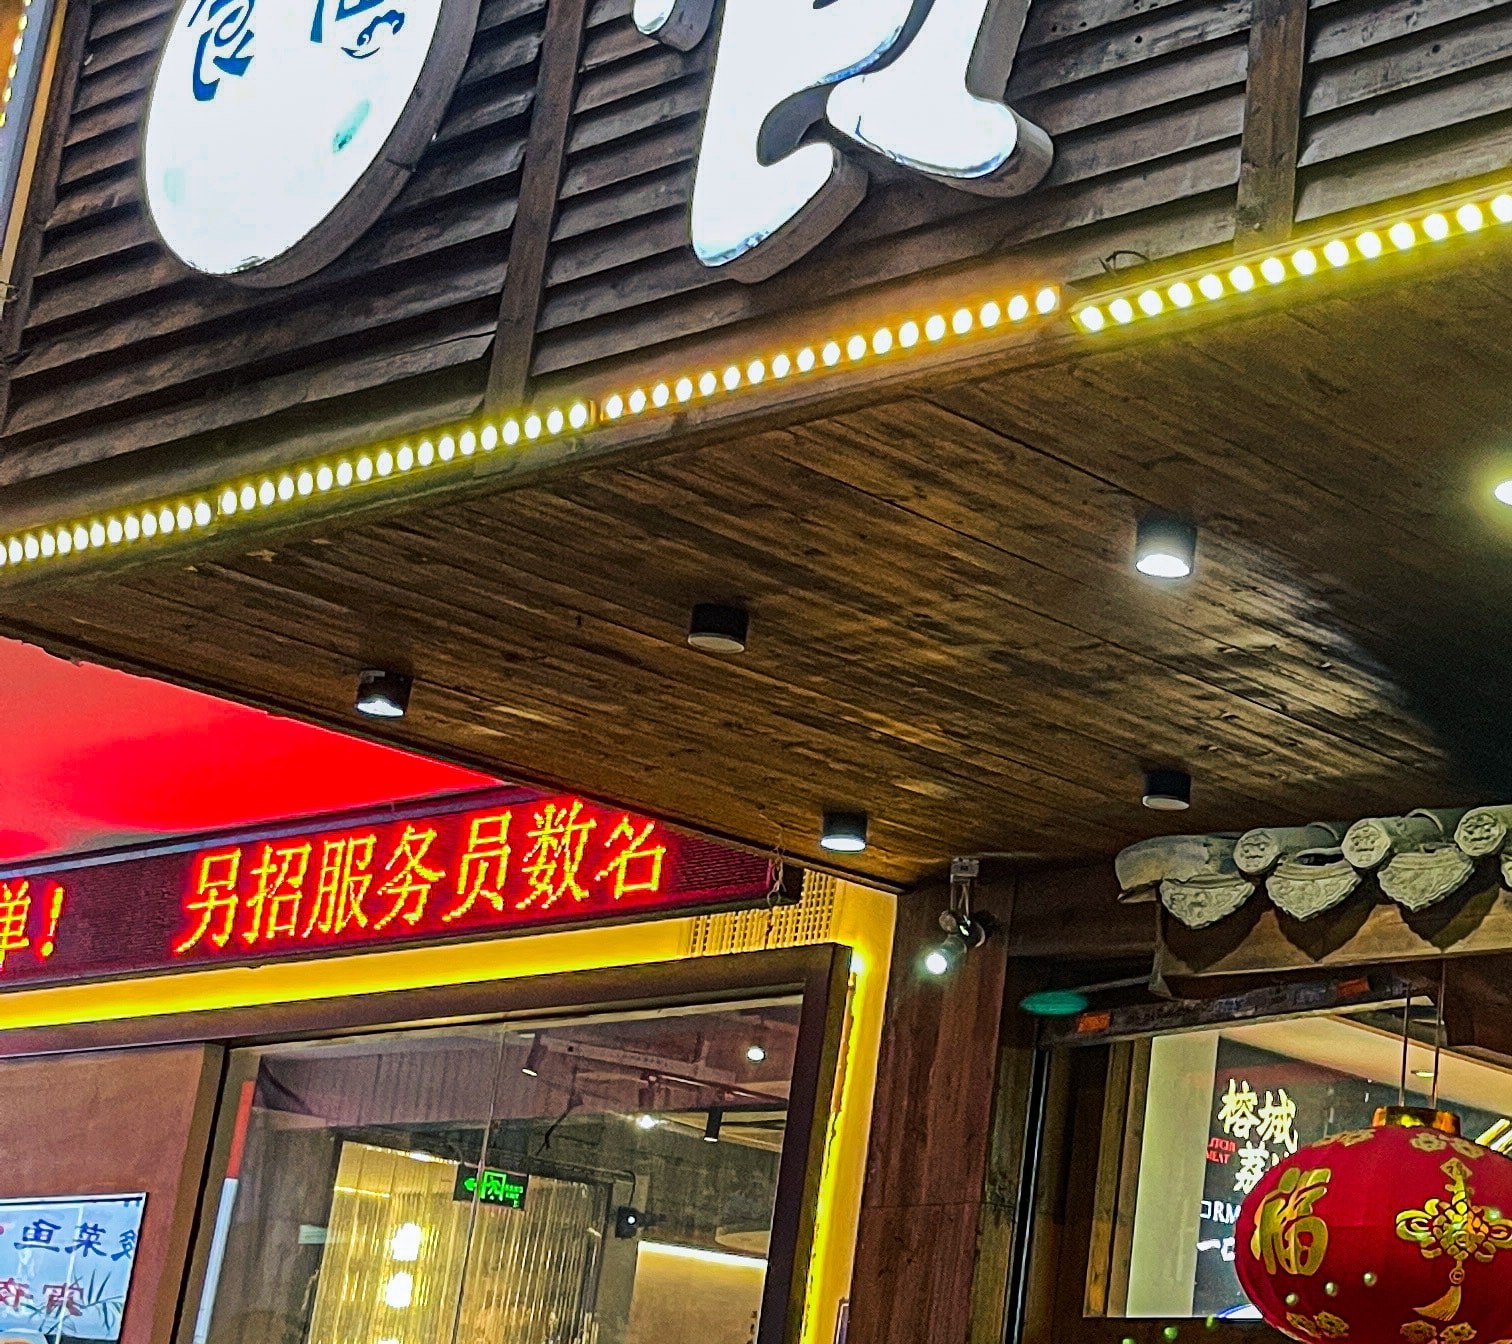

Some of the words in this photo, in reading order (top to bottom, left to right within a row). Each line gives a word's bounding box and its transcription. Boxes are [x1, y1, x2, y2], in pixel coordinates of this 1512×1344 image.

[173, 798, 668, 955] 另招服务员数名
[1249, 1166, 1332, 1277] 福
